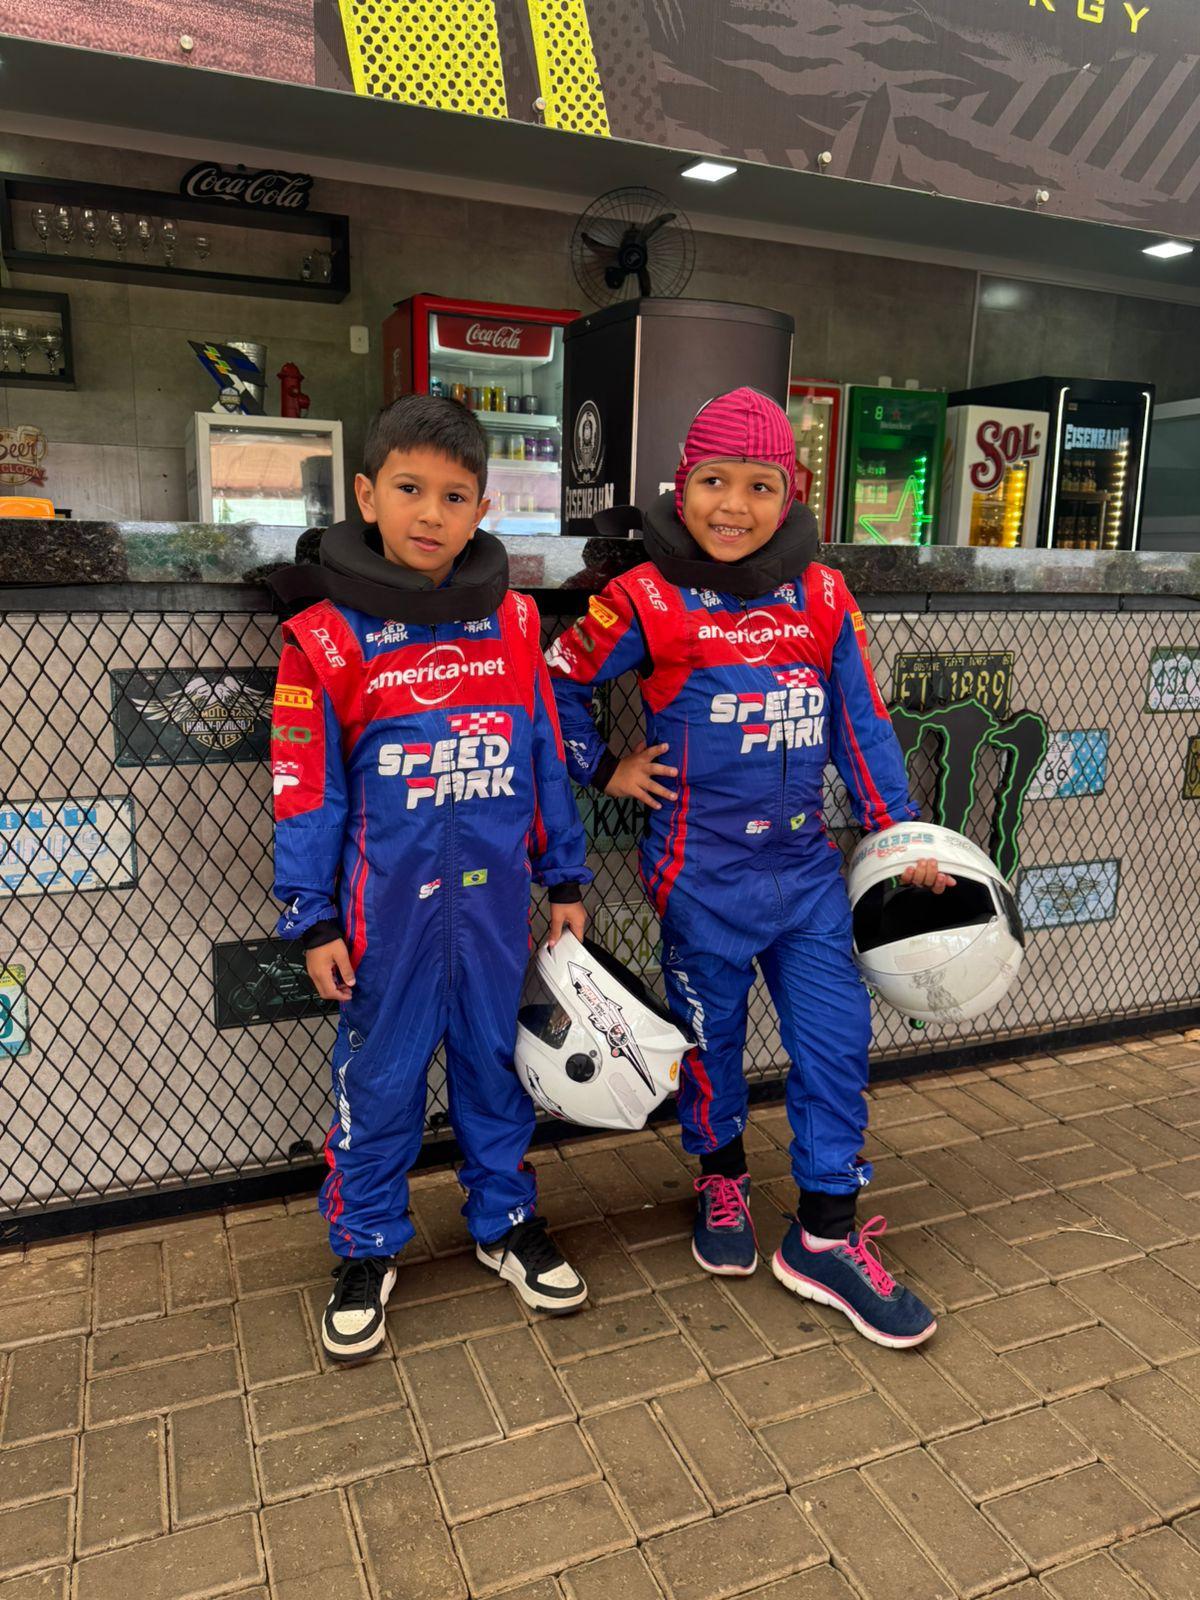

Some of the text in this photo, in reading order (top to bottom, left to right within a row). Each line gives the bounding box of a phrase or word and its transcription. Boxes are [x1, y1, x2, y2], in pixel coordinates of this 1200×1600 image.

[187, 167, 308, 208] Coca-Cola
[466, 323, 523, 349] Coca-Cola
[970, 420, 1040, 490] SOL
[710, 686, 825, 723] SPEED
[378, 735, 510, 776] SPEED
[740, 716, 825, 754] PARK
[406, 766, 516, 810] PARK
